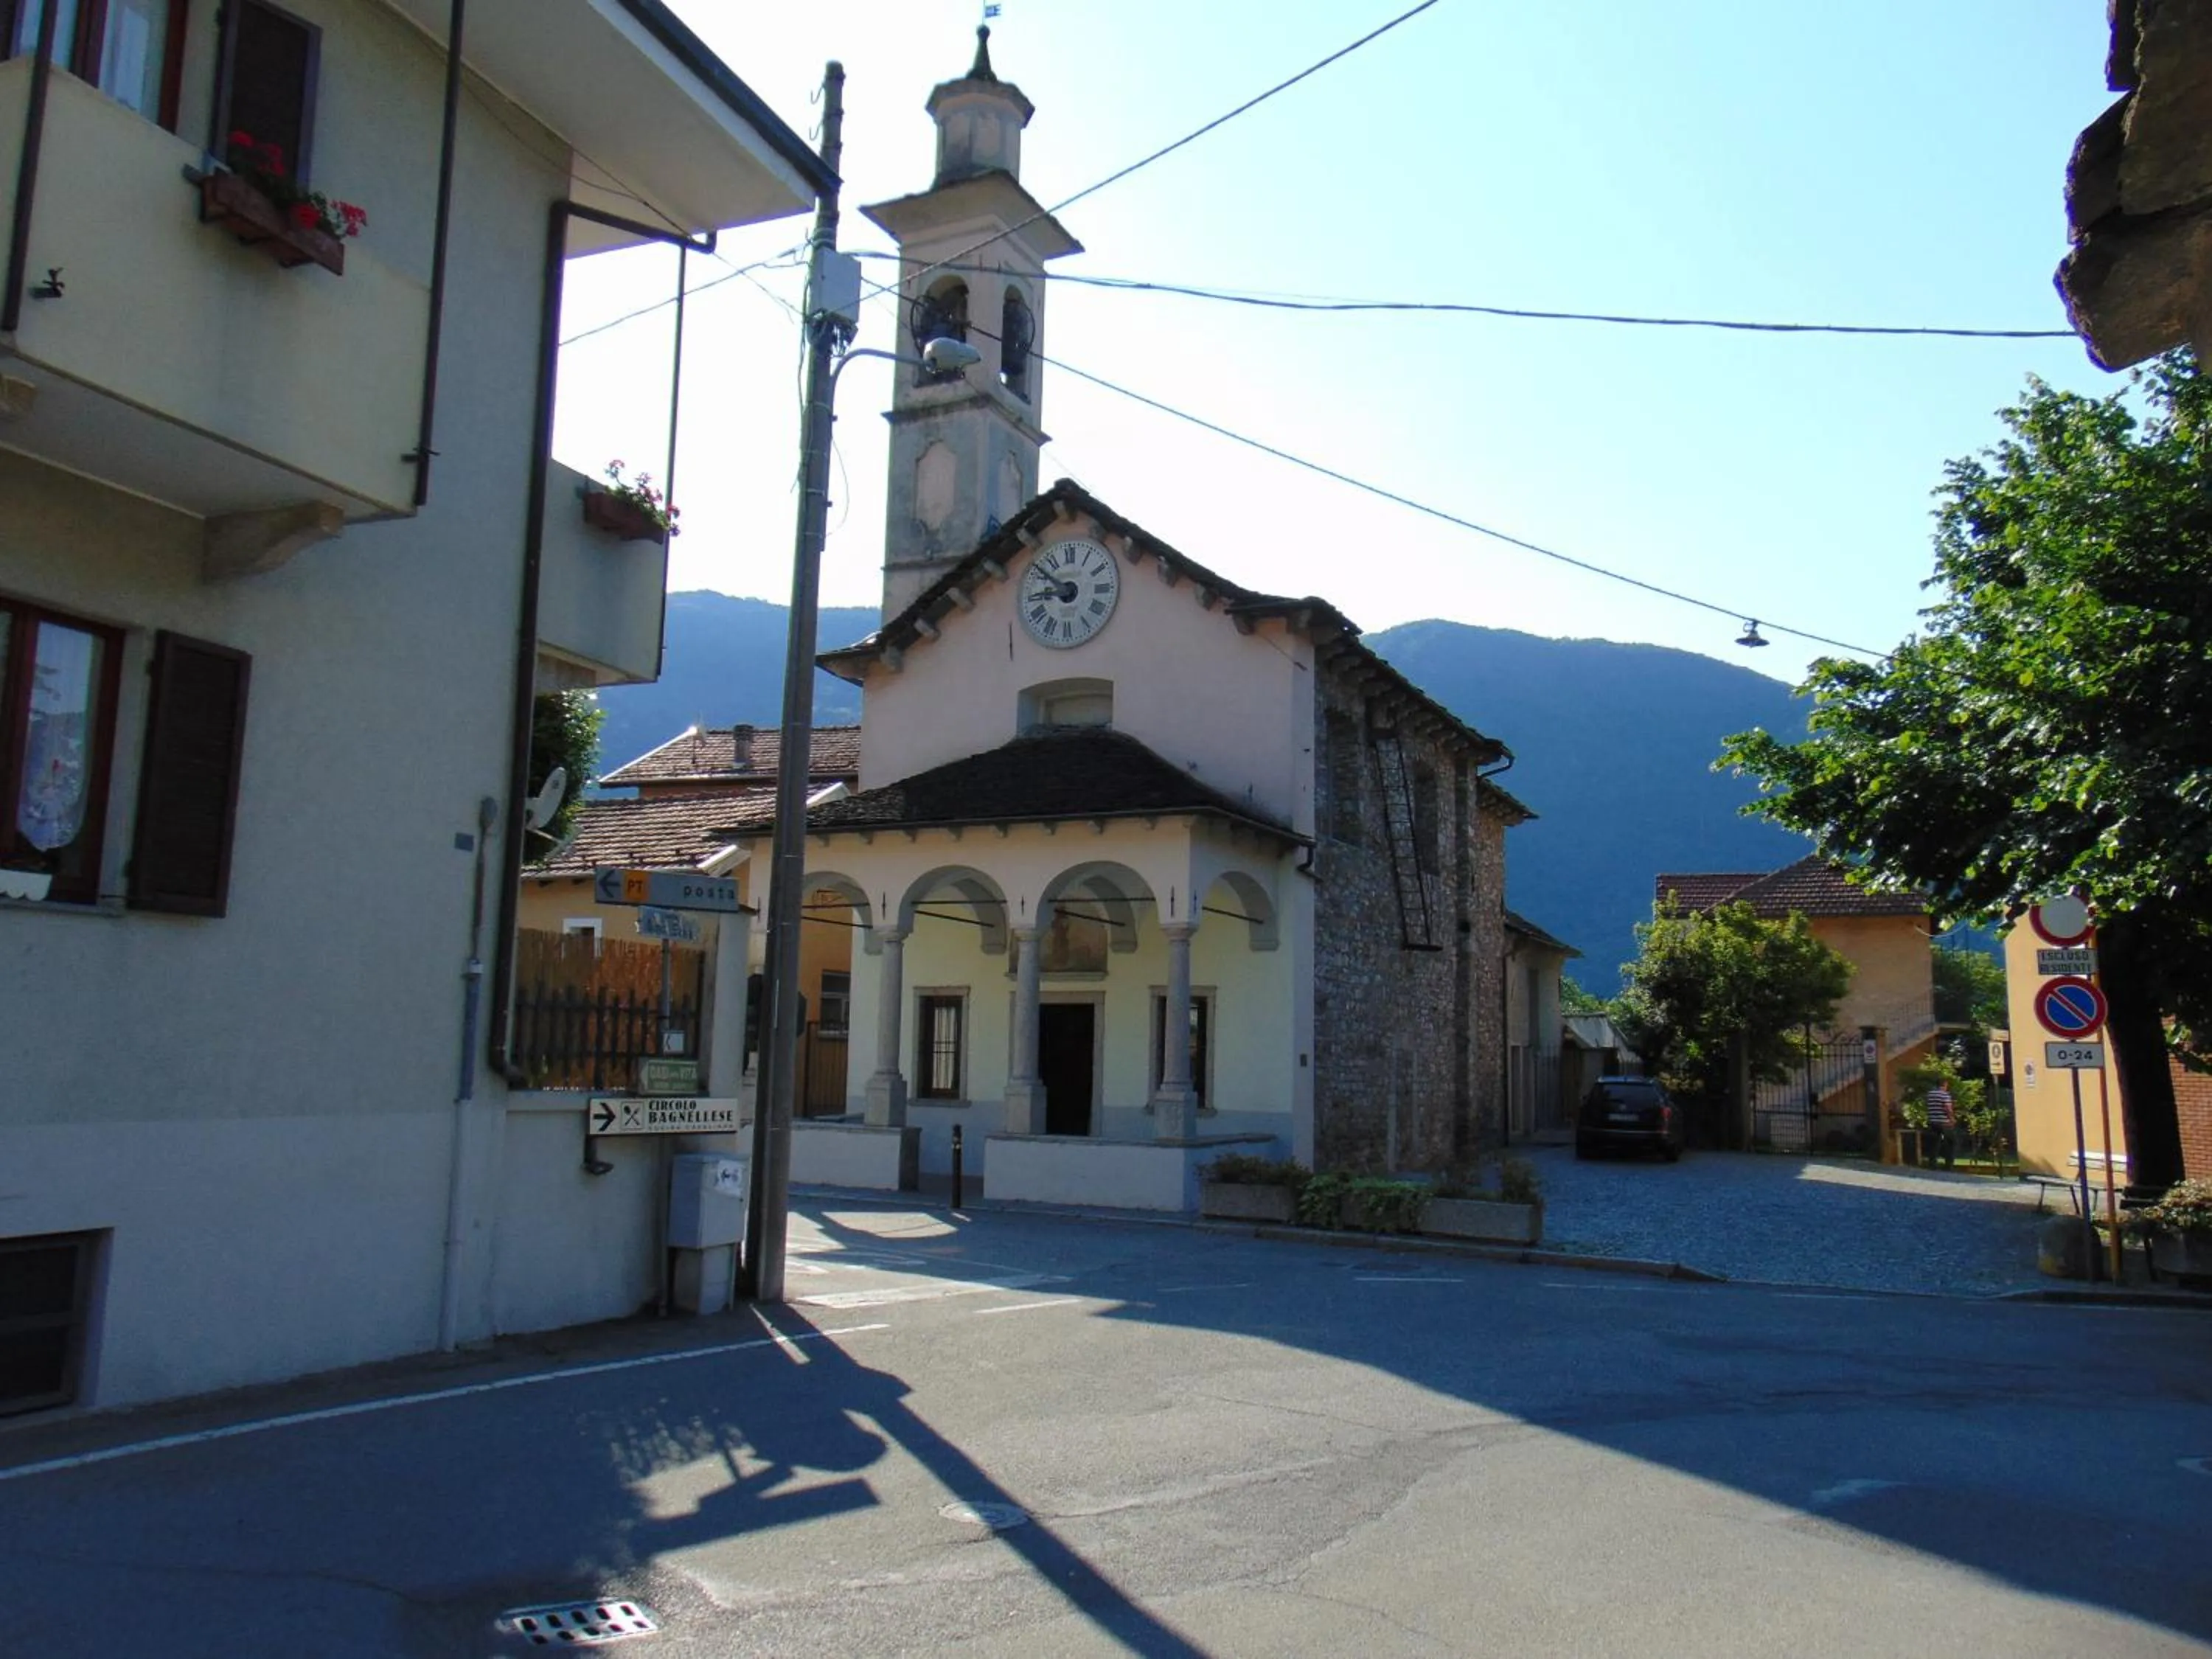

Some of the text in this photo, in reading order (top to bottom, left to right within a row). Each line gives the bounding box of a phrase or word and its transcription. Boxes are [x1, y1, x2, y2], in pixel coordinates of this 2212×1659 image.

[627, 880, 735, 900] PT posta
[2057, 1050, 2093, 1060] 0-24
[649, 1099, 697, 1110] CIRCOLO
[649, 1110, 734, 1124] BAGNELLESE
